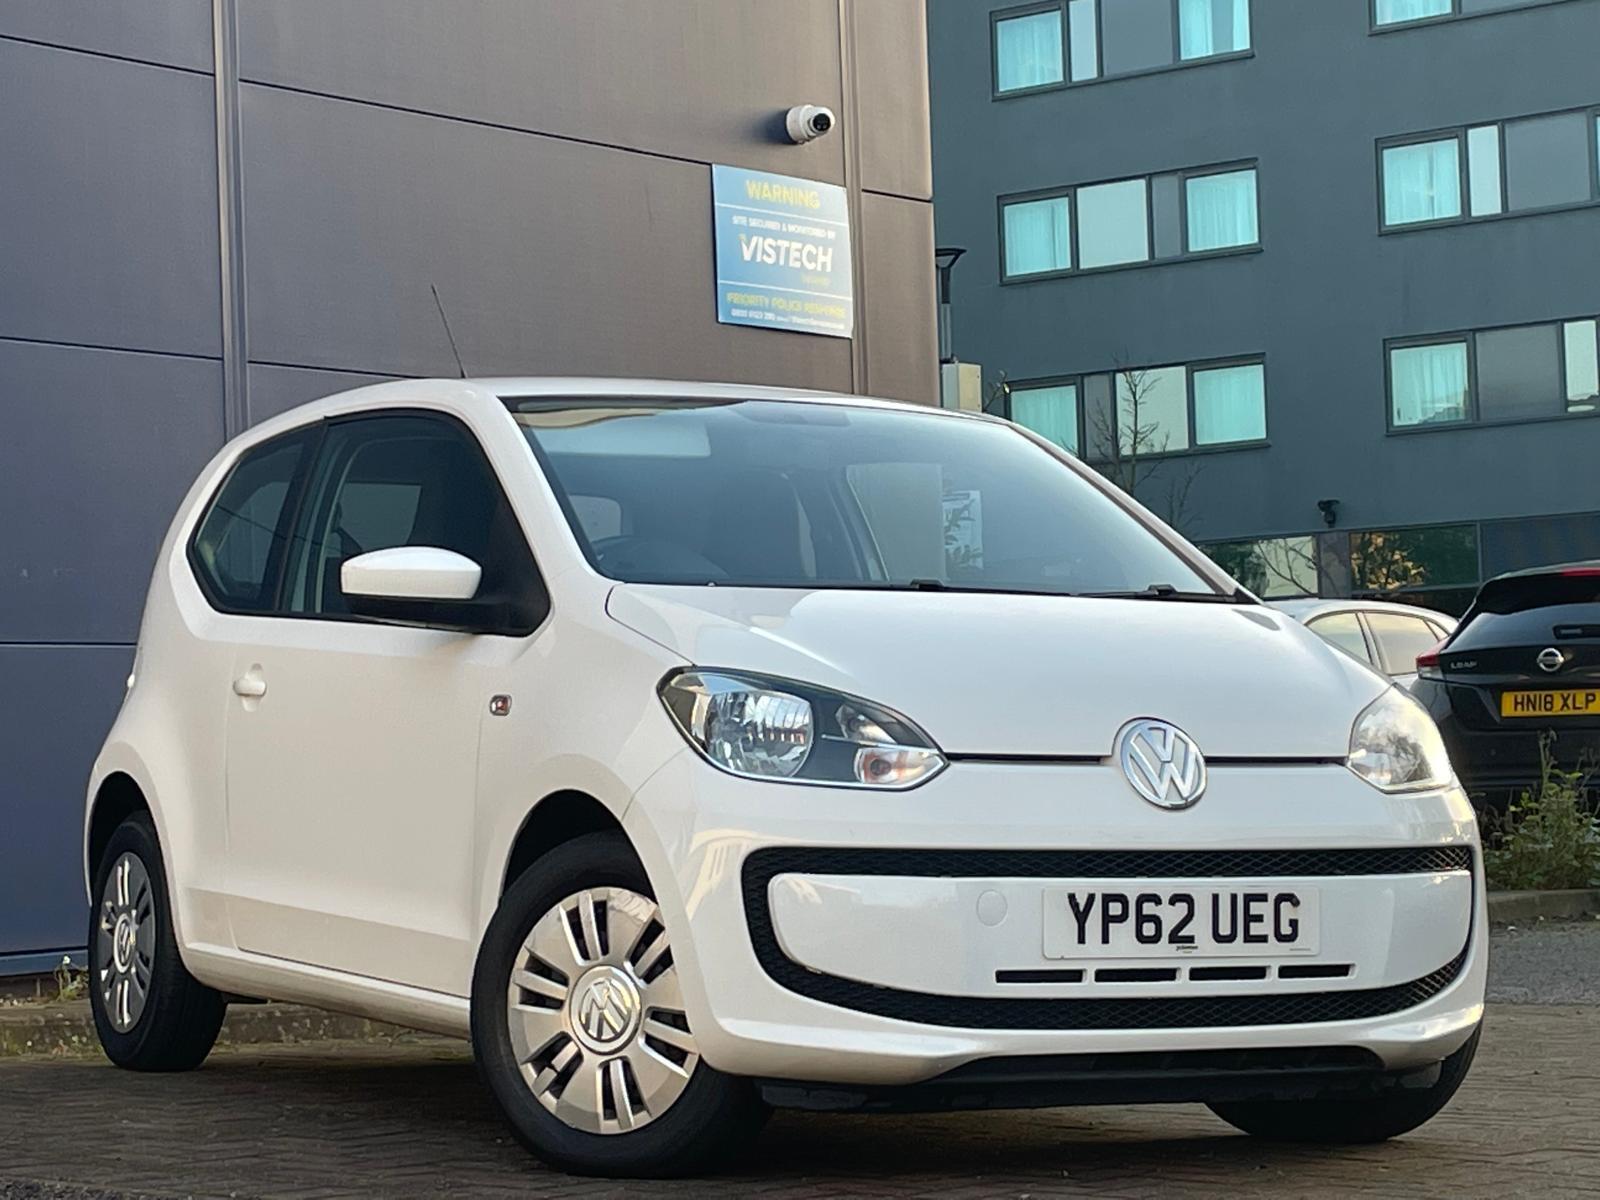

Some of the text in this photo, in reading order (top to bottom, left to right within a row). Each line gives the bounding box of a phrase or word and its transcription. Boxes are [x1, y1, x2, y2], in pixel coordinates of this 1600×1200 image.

[746, 180, 820, 209] WARNING
[740, 235, 833, 273] VISTECH
[1513, 692, 1597, 712] HN18 XLP
[1067, 892, 1301, 945] YP62 UEG
